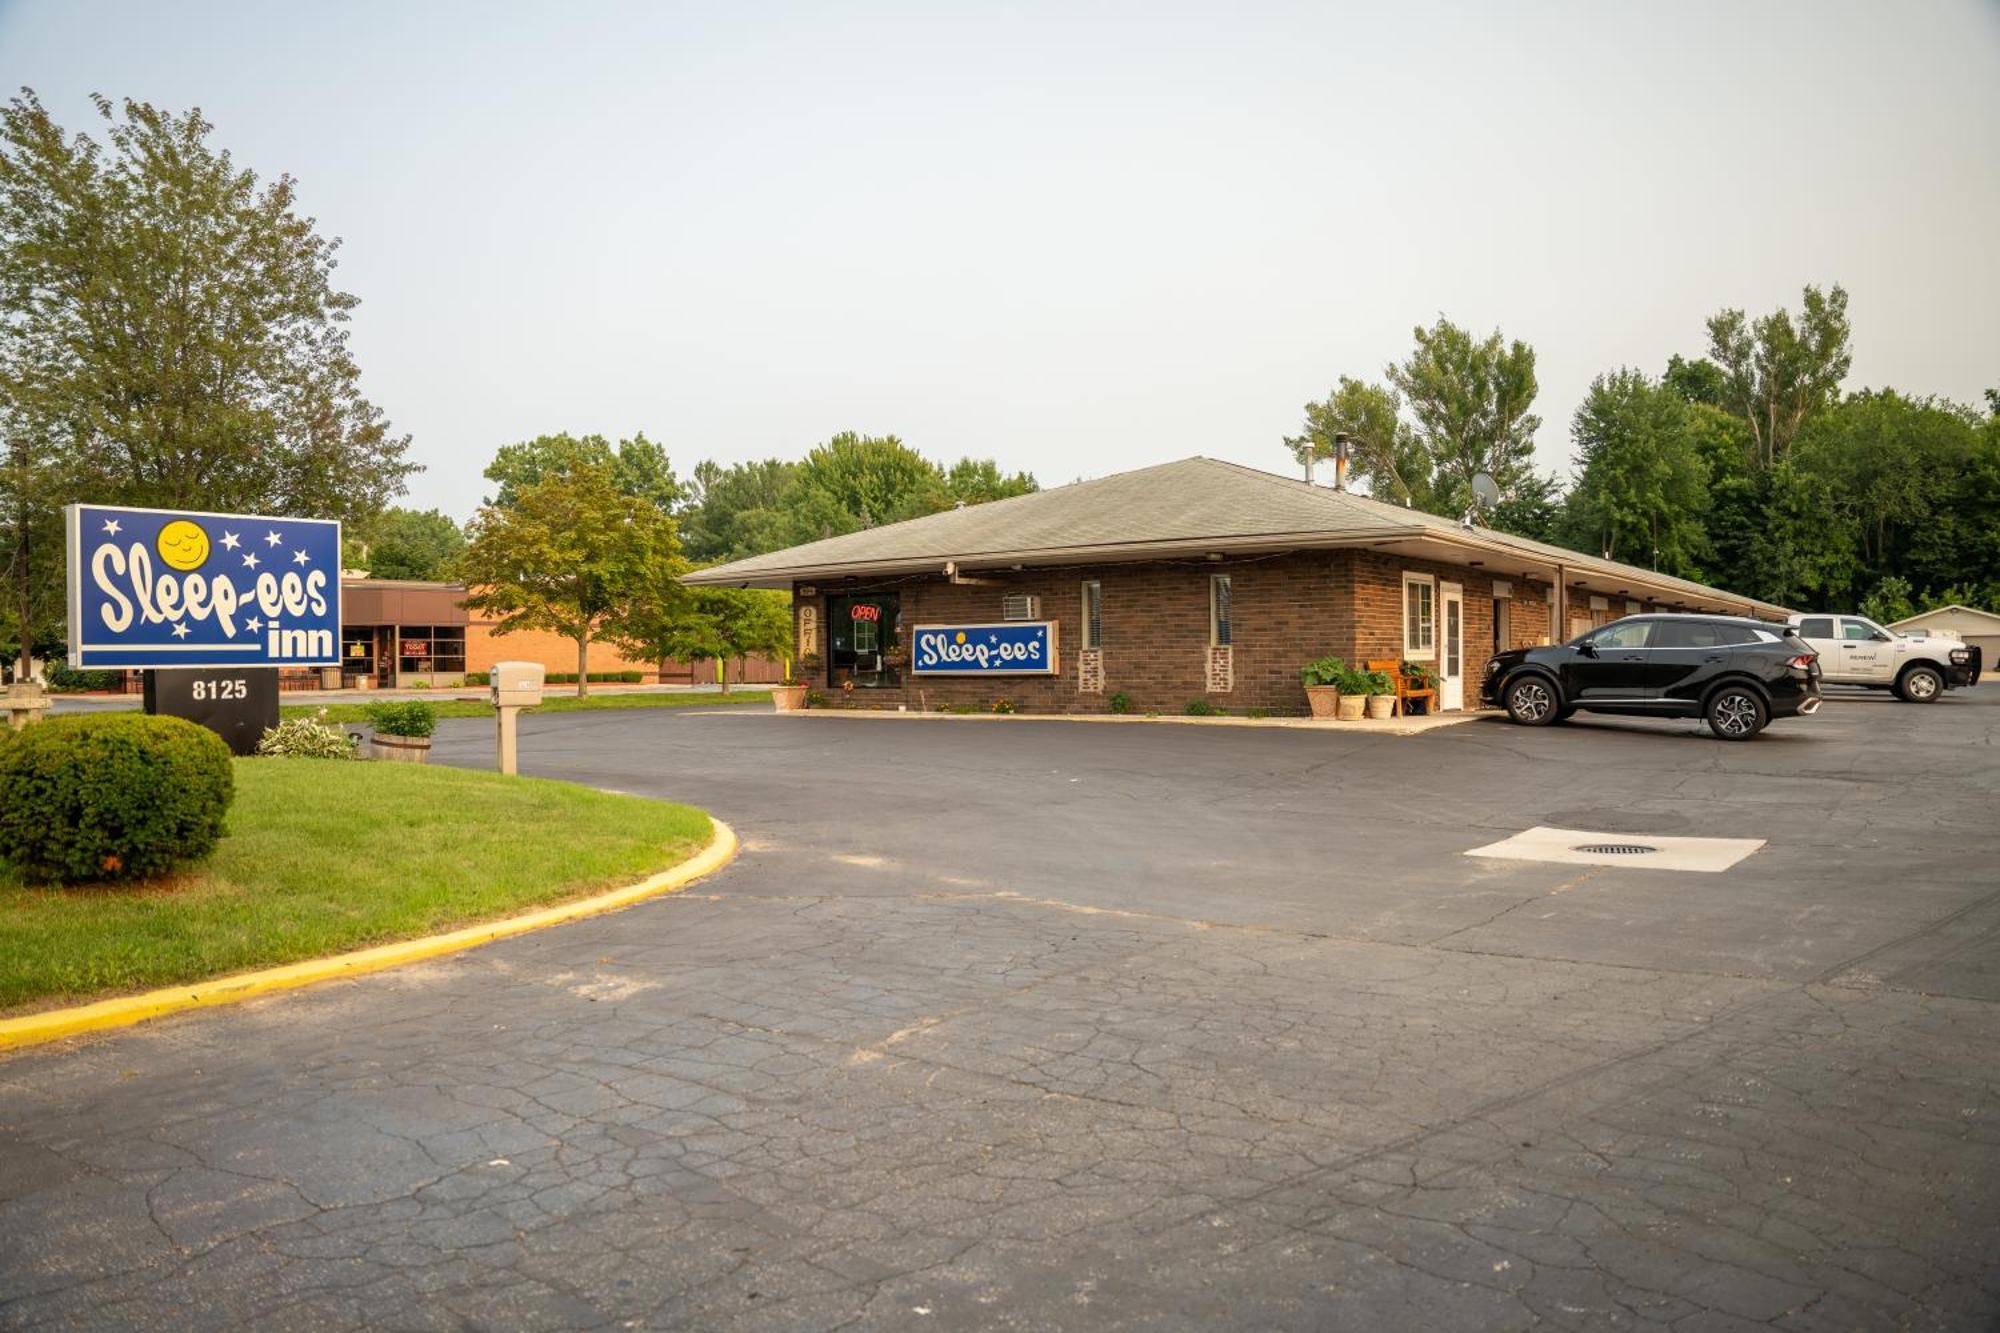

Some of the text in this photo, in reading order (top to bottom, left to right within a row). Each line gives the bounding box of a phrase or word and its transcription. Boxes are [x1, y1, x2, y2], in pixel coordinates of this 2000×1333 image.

[92, 542, 327, 639] Sleep-ees
[851, 604, 879, 621] OPEN
[267, 620, 333, 658] inn
[803, 608, 813, 659] OFFIC
[920, 633, 1040, 668] Sleep-ees
[192, 679, 247, 700] 8125
